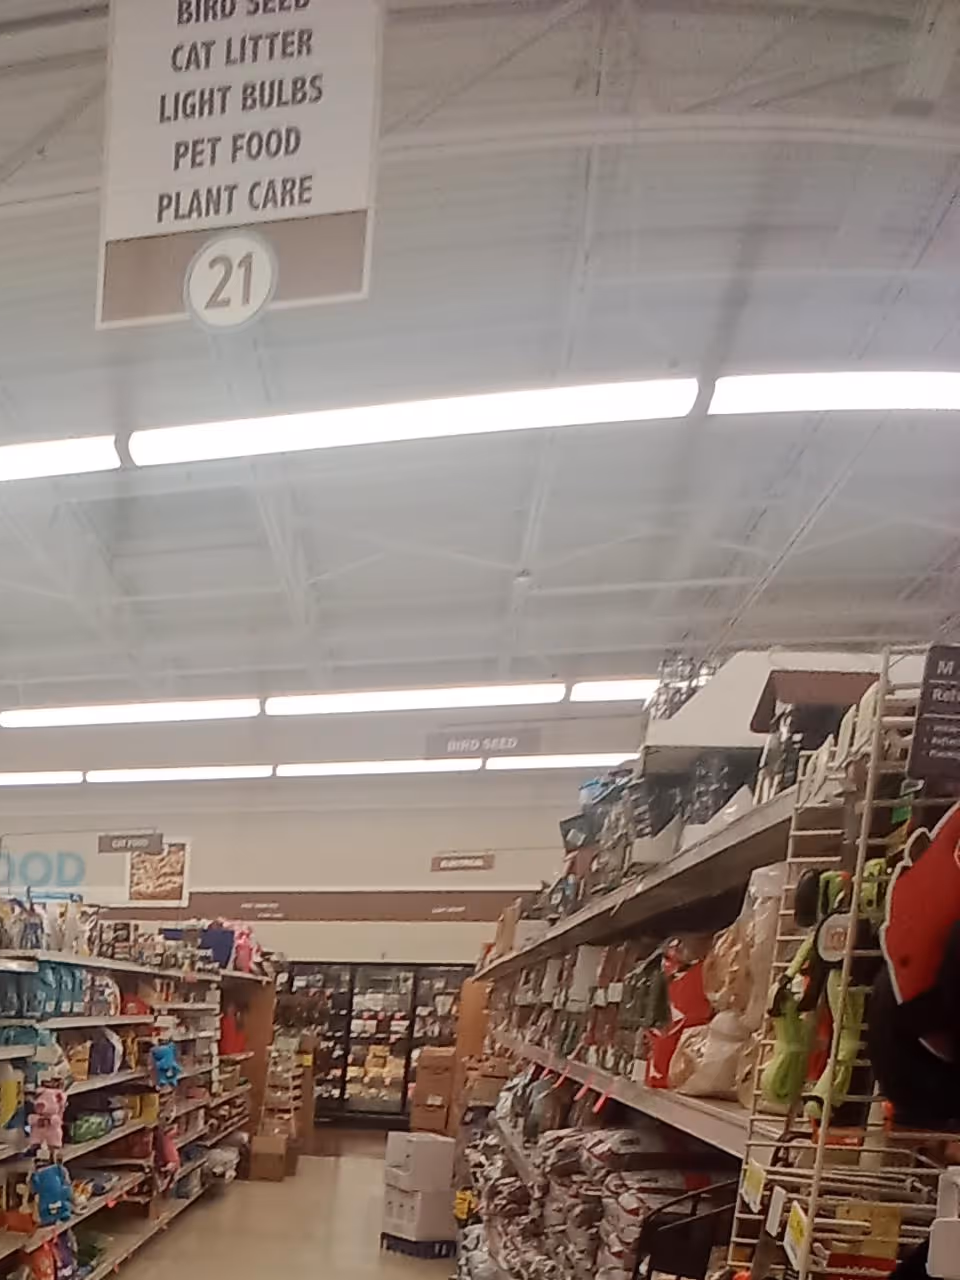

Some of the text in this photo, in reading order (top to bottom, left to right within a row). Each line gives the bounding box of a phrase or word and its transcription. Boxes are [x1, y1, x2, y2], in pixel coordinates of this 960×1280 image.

[177, 0, 235, 25] BIRD
[171, 28, 313, 72] CAT LITTER
[159, 74, 323, 123] LIGHT BULBS
[173, 126, 301, 171] PET FOOD
[157, 175, 313, 223] PLANT CARE
[204, 251, 255, 310] 21
[447, 736, 519, 753] BIRD SEED
